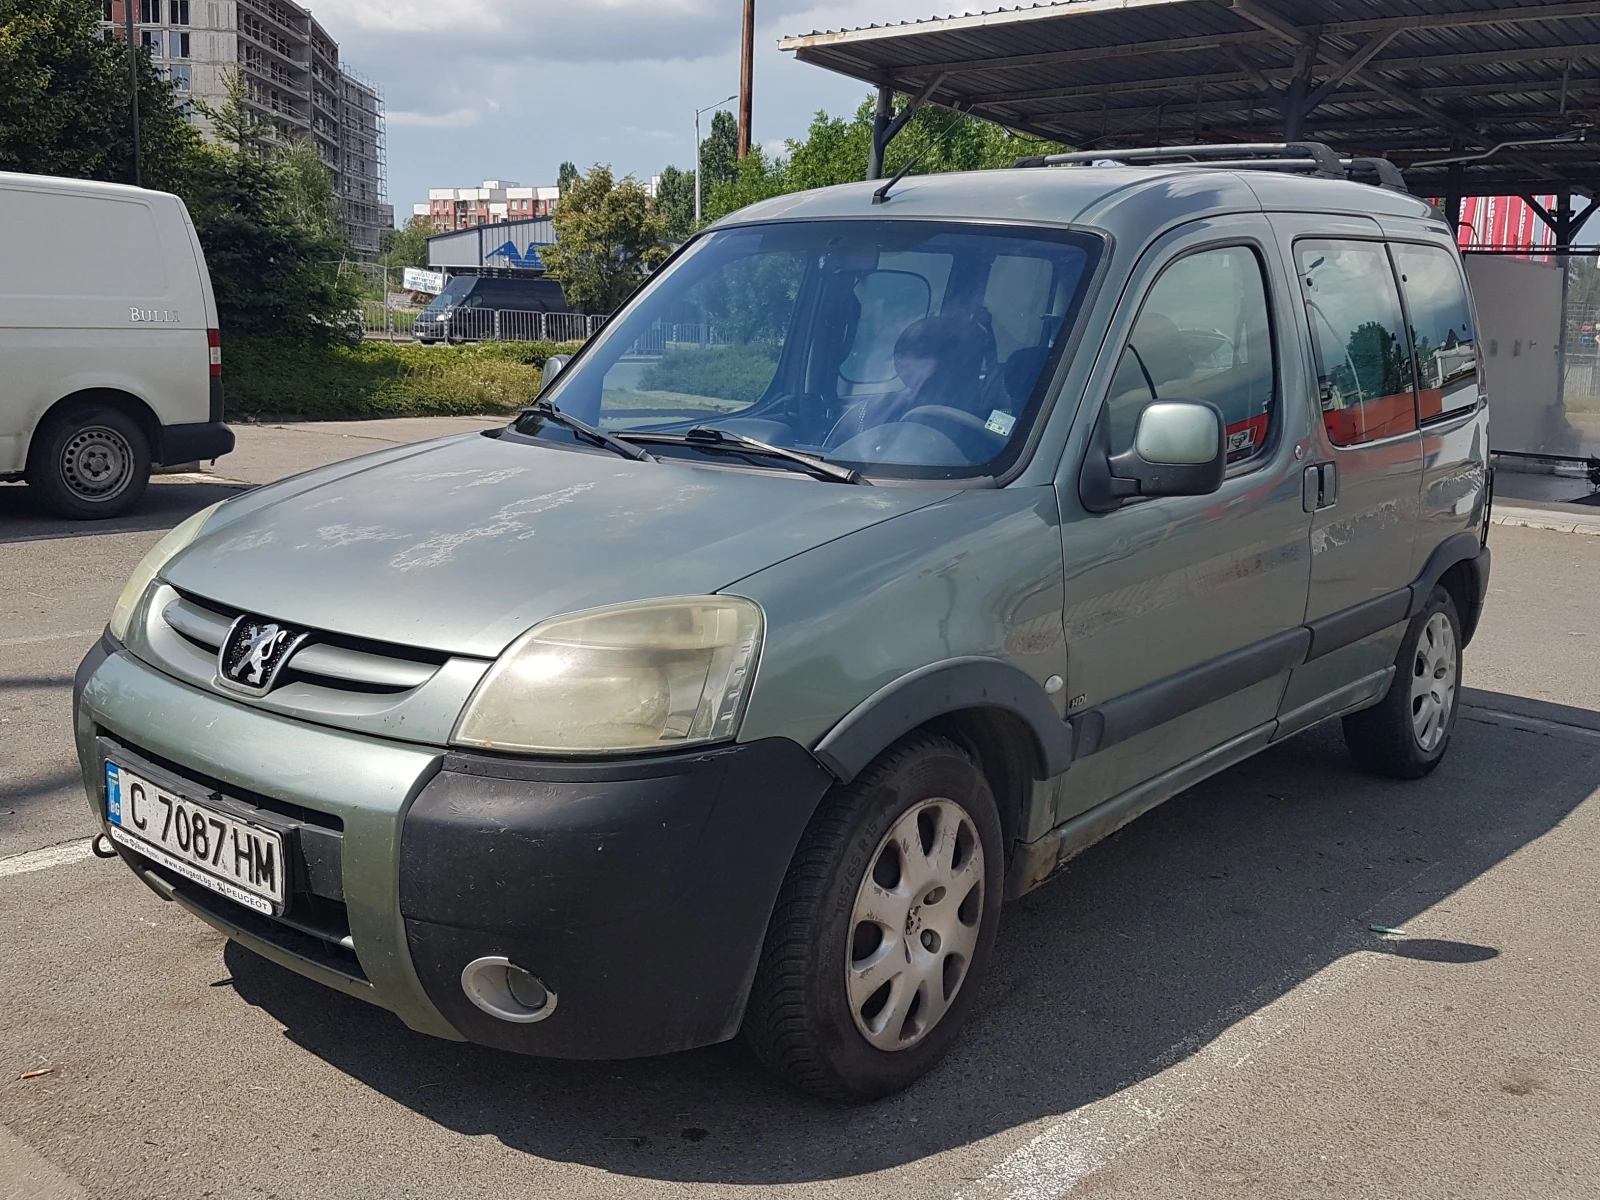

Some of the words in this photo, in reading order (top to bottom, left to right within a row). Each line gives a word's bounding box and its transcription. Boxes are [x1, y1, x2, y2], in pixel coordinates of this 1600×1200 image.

[129, 307, 180, 322] BULLI
[131, 782, 147, 831] C
[158, 795, 227, 866] 7087
[233, 827, 276, 893] HM
[227, 887, 267, 911] PEUGEOT
